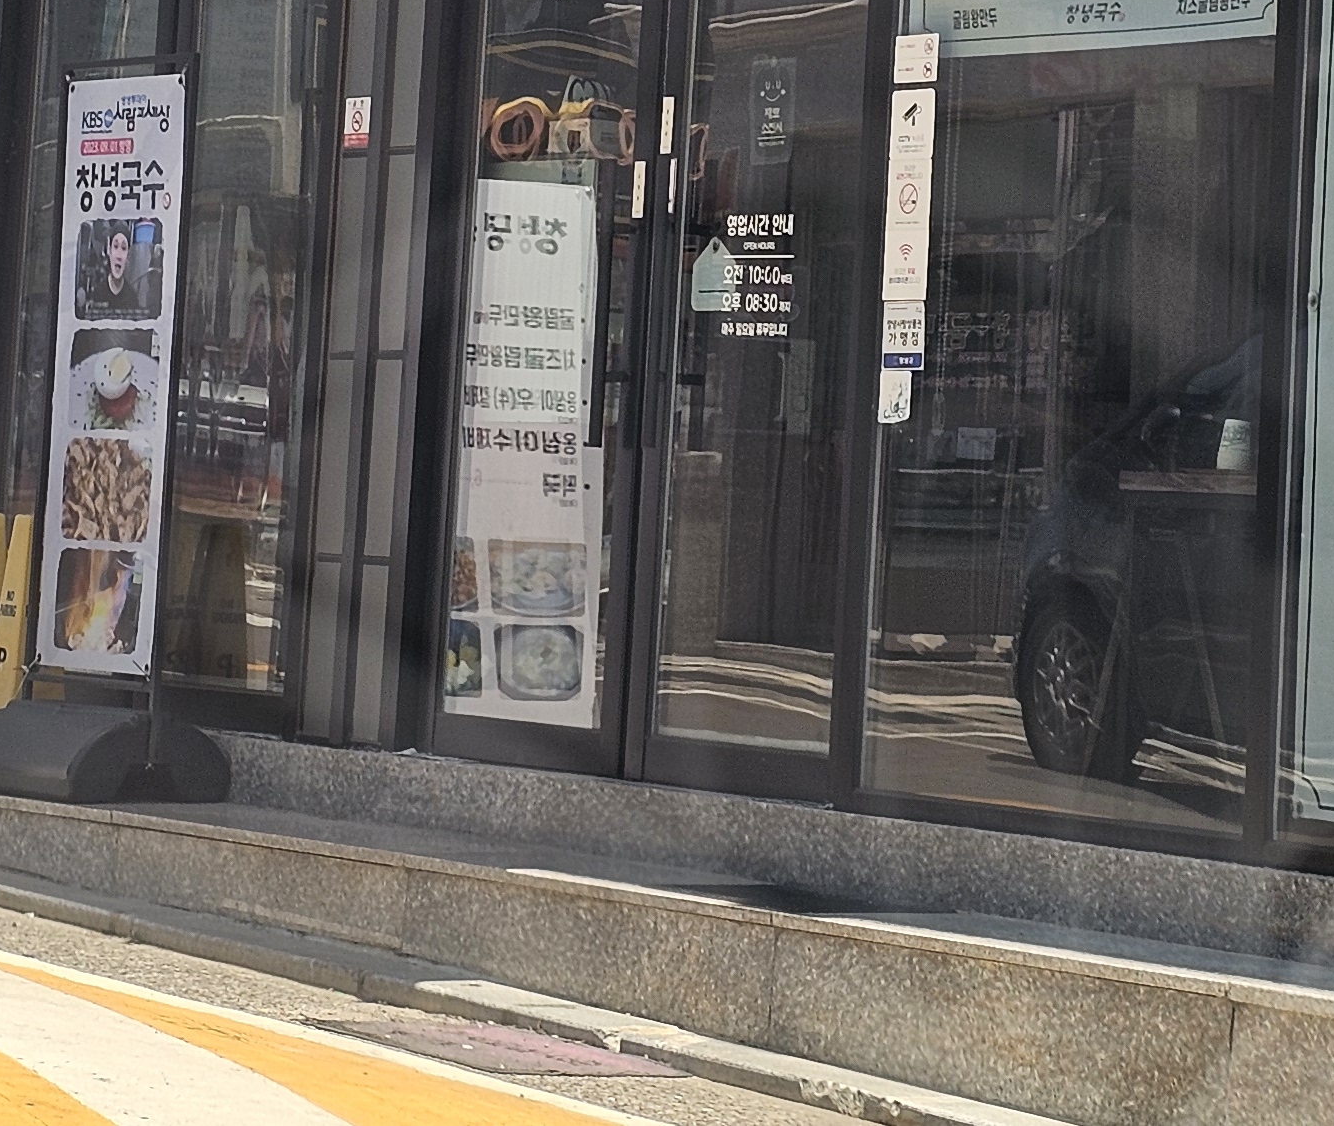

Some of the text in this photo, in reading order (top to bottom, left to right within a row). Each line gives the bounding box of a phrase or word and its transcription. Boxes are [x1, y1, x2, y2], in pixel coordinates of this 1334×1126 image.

[953, 8, 998, 30] 굴림왕만두
[1066, 2, 1121, 24] 창녕국수
[81, 110, 104, 129] KBS
[76, 160, 165, 212] 창녕국수
[727, 214, 795, 237] 영업시간 안내
[723, 264, 744, 284] 오전
